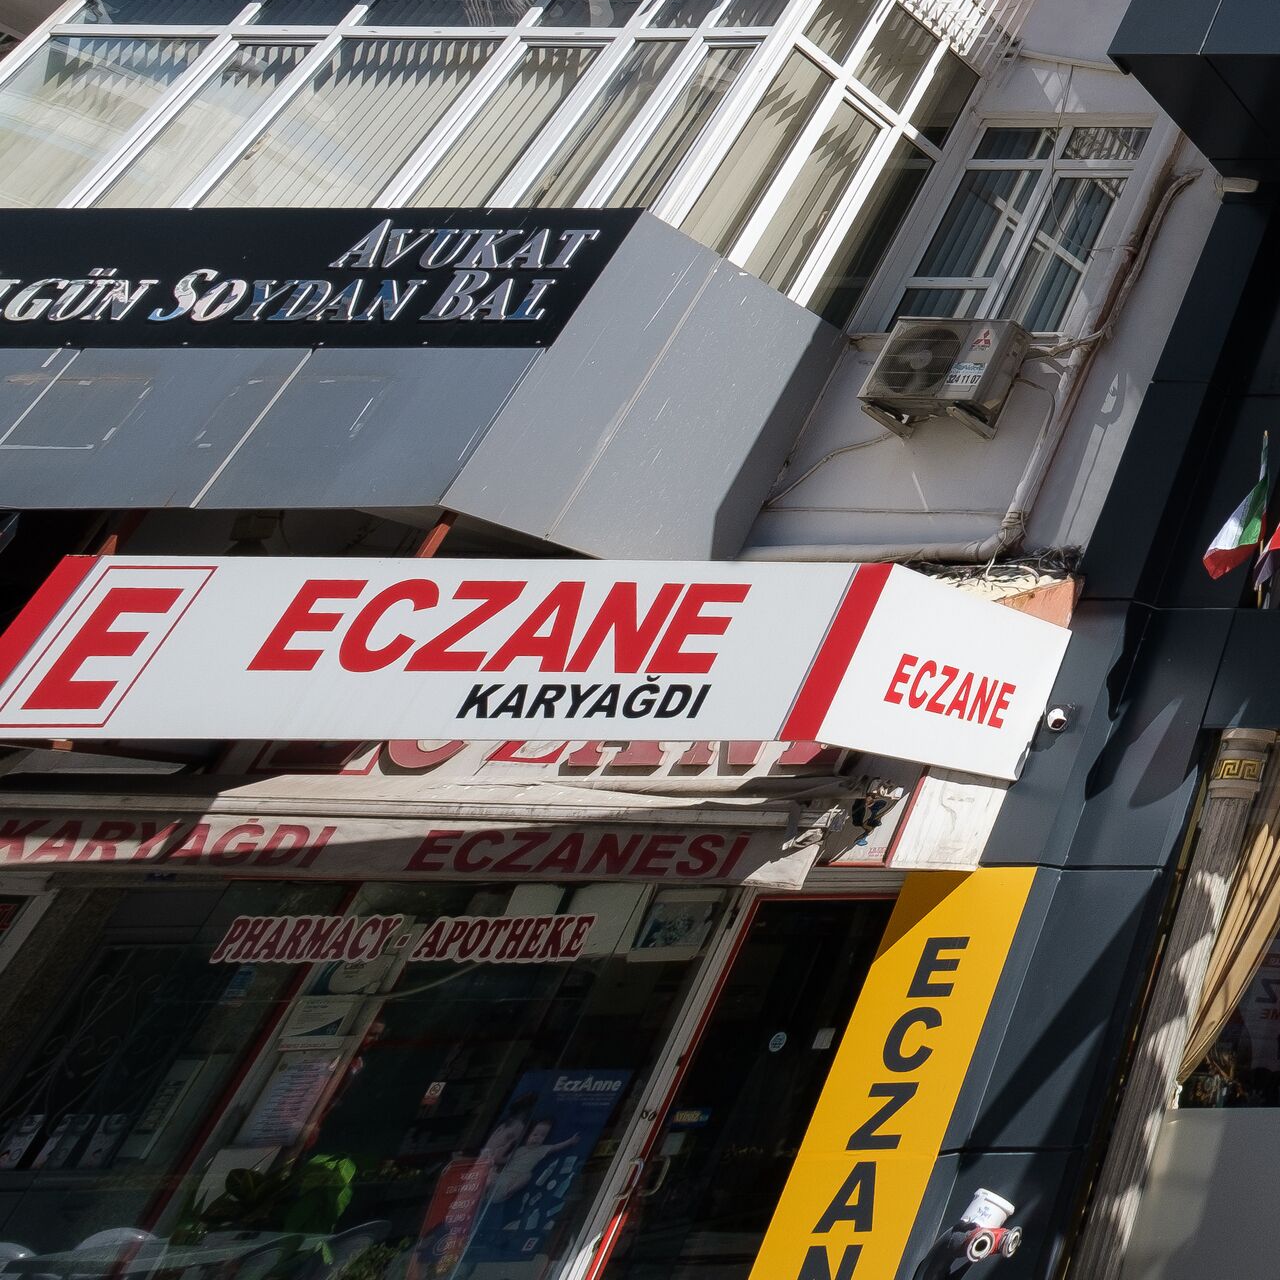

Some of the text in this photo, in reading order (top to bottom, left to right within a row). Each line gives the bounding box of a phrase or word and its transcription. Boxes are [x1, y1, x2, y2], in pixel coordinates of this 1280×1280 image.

[328, 218, 601, 269] AVUKAT
[148, 267, 427, 323] SOYDAN
[418, 269, 558, 322] BAL
[21, 587, 185, 710] E
[246, 577, 753, 675] ECZANE
[456, 673, 713, 719] KARYAĞDI
[883, 653, 1017, 729] ECZANE
[0, 816, 750, 879] KARYAĞDI ECZANESİ
[211, 914, 404, 963] PHARMACY
[409, 913, 598, 964] APOTHEKE
